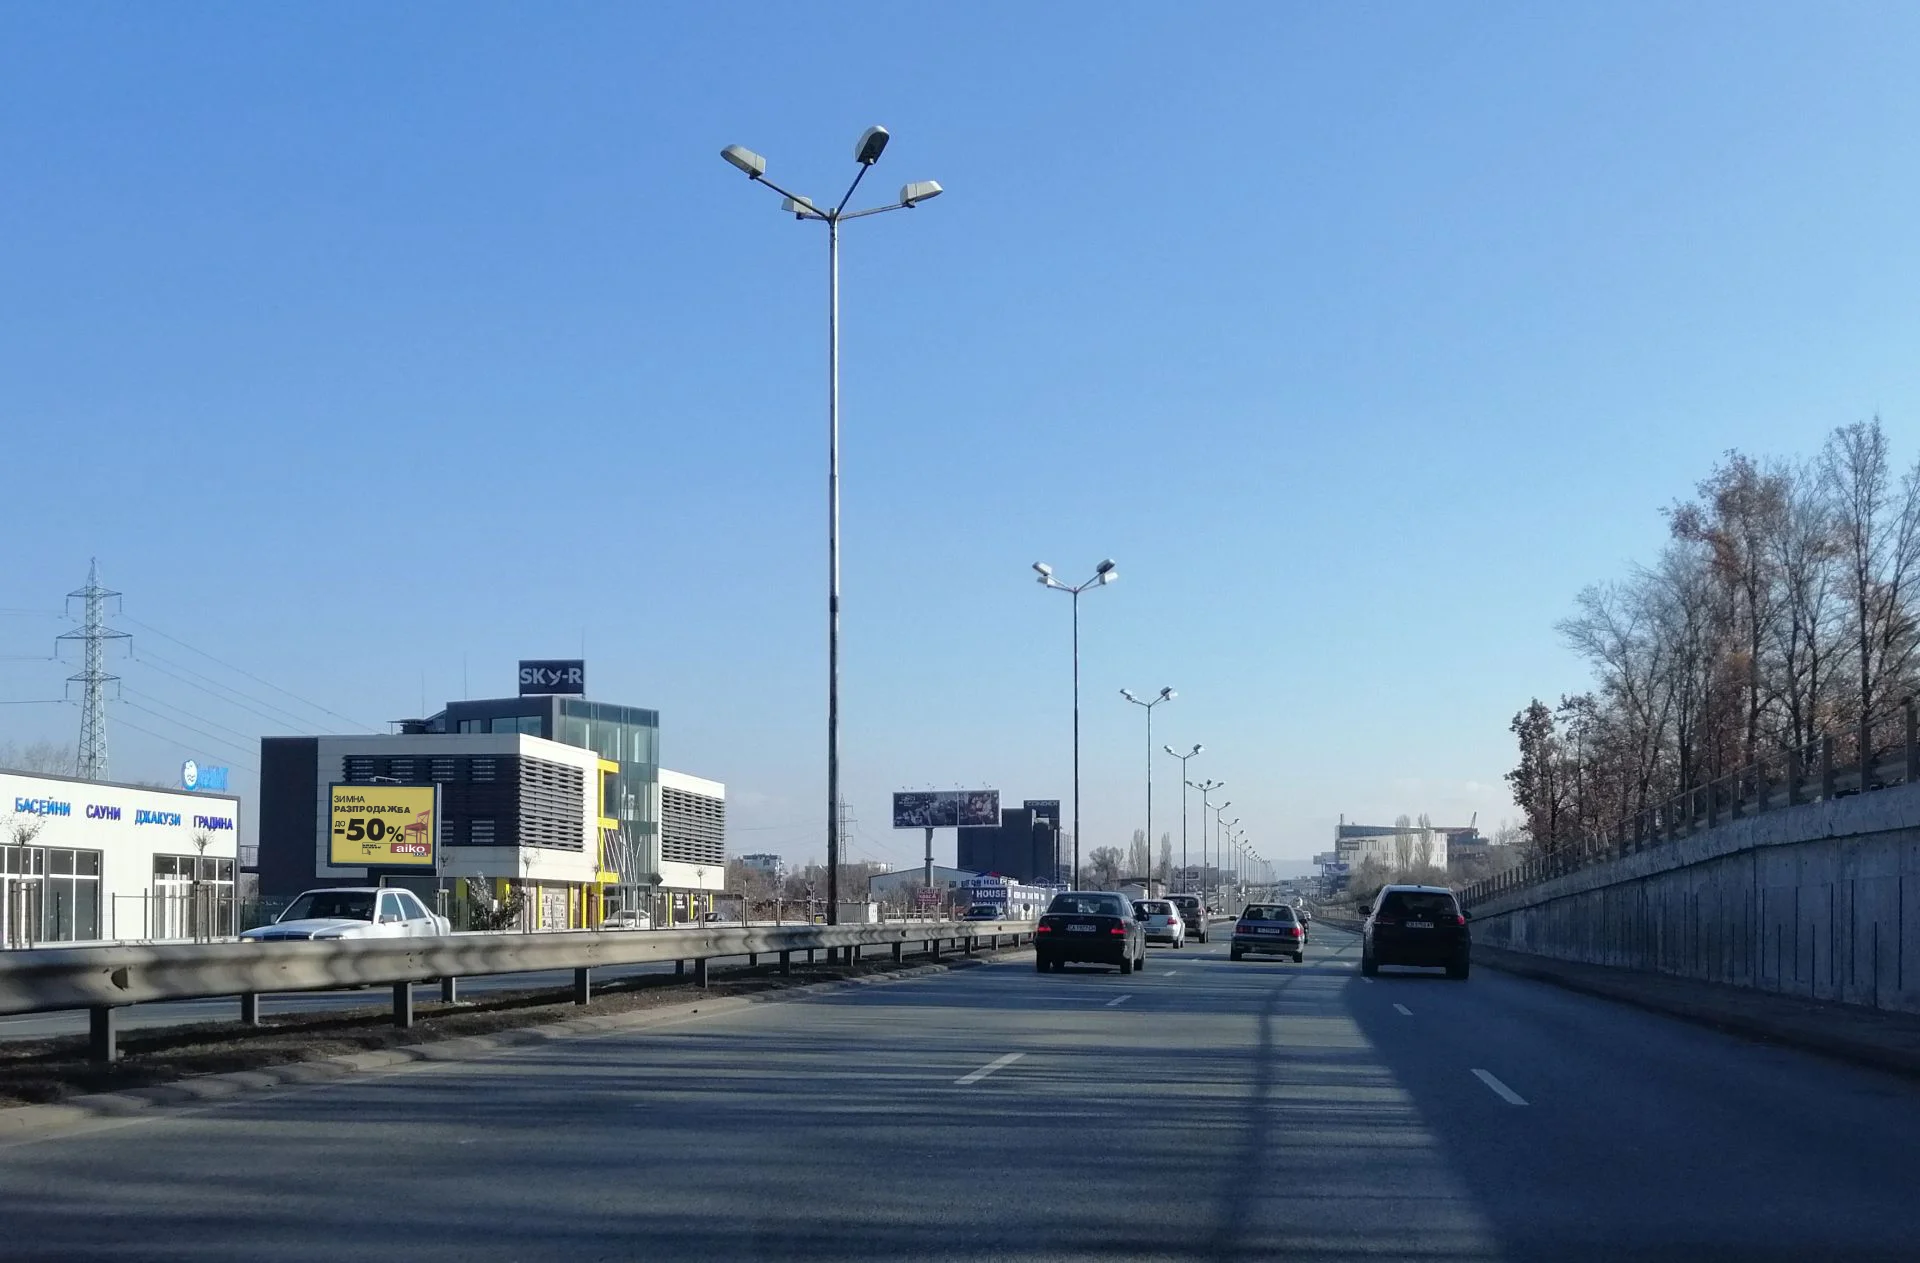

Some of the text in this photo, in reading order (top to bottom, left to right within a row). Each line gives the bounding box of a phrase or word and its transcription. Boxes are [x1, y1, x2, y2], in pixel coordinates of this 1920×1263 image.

[334, 795, 365, 803] ЗИМНА
[15, 797, 233, 831] БАСЕЙНИ САУНИ ДЖАКУЗИ ГРАДИНА
[334, 805, 410, 814] РАЗПРОДАЖБА
[334, 818, 404, 842] -50%
[396, 843, 425, 853] aiko
[976, 890, 1006, 898] HOUSE
